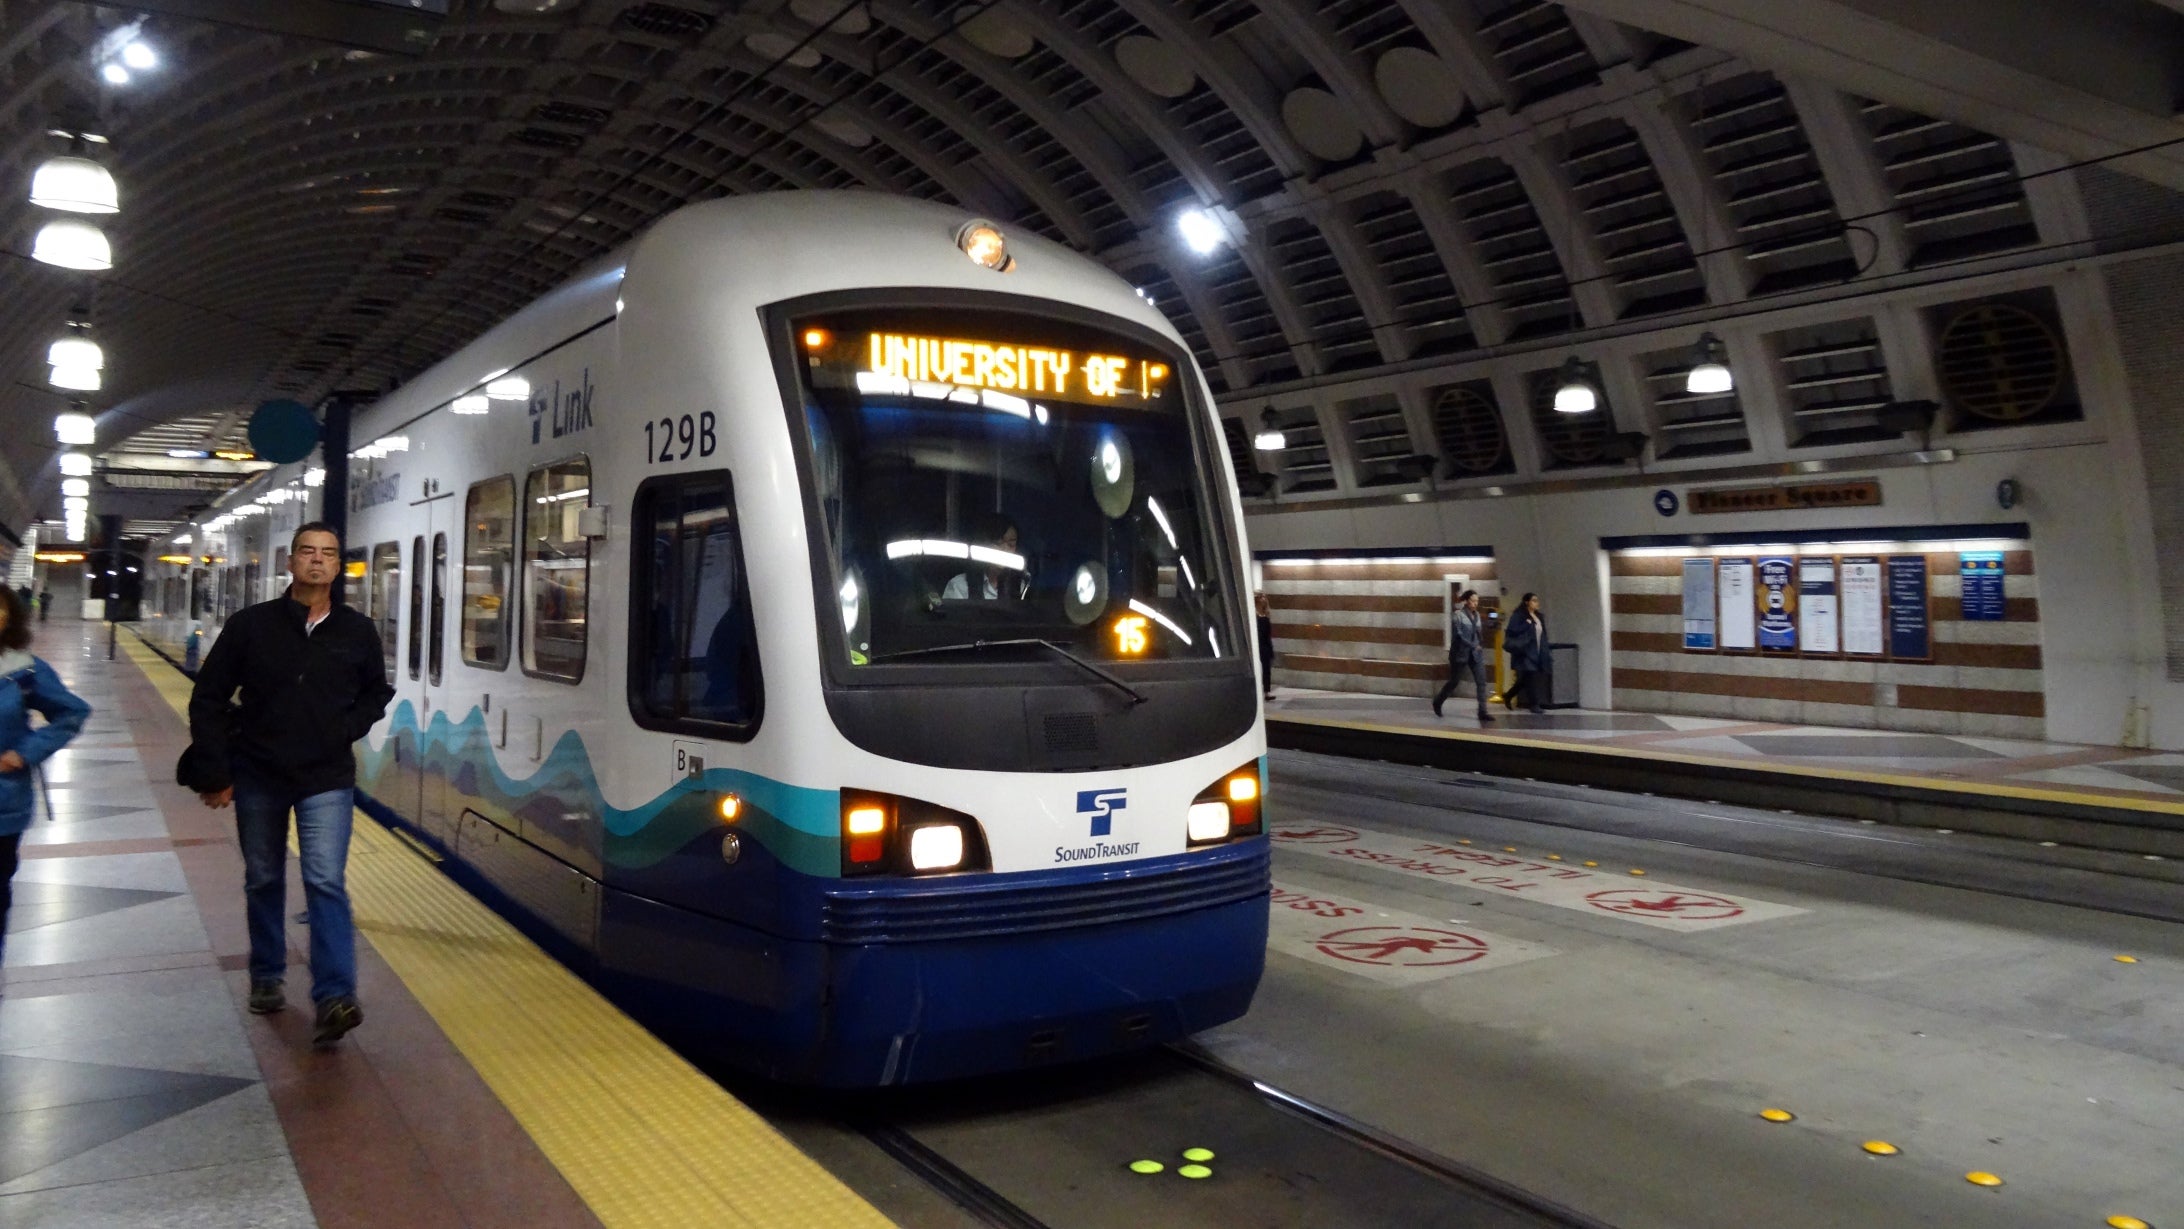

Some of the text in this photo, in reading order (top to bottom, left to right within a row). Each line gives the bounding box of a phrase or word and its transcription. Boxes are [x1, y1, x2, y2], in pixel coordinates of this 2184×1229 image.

[871, 333, 1070, 393] UNIVERSITY
[1085, 355, 1127, 397] OF
[552, 367, 594, 438] Link
[645, 410, 716, 464] 129B
[1114, 616, 1147, 654] 15
[677, 749, 686, 771] B
[1329, 848, 1539, 891] TO CROSS
[1413, 844, 1592, 879] ILLEGAL
